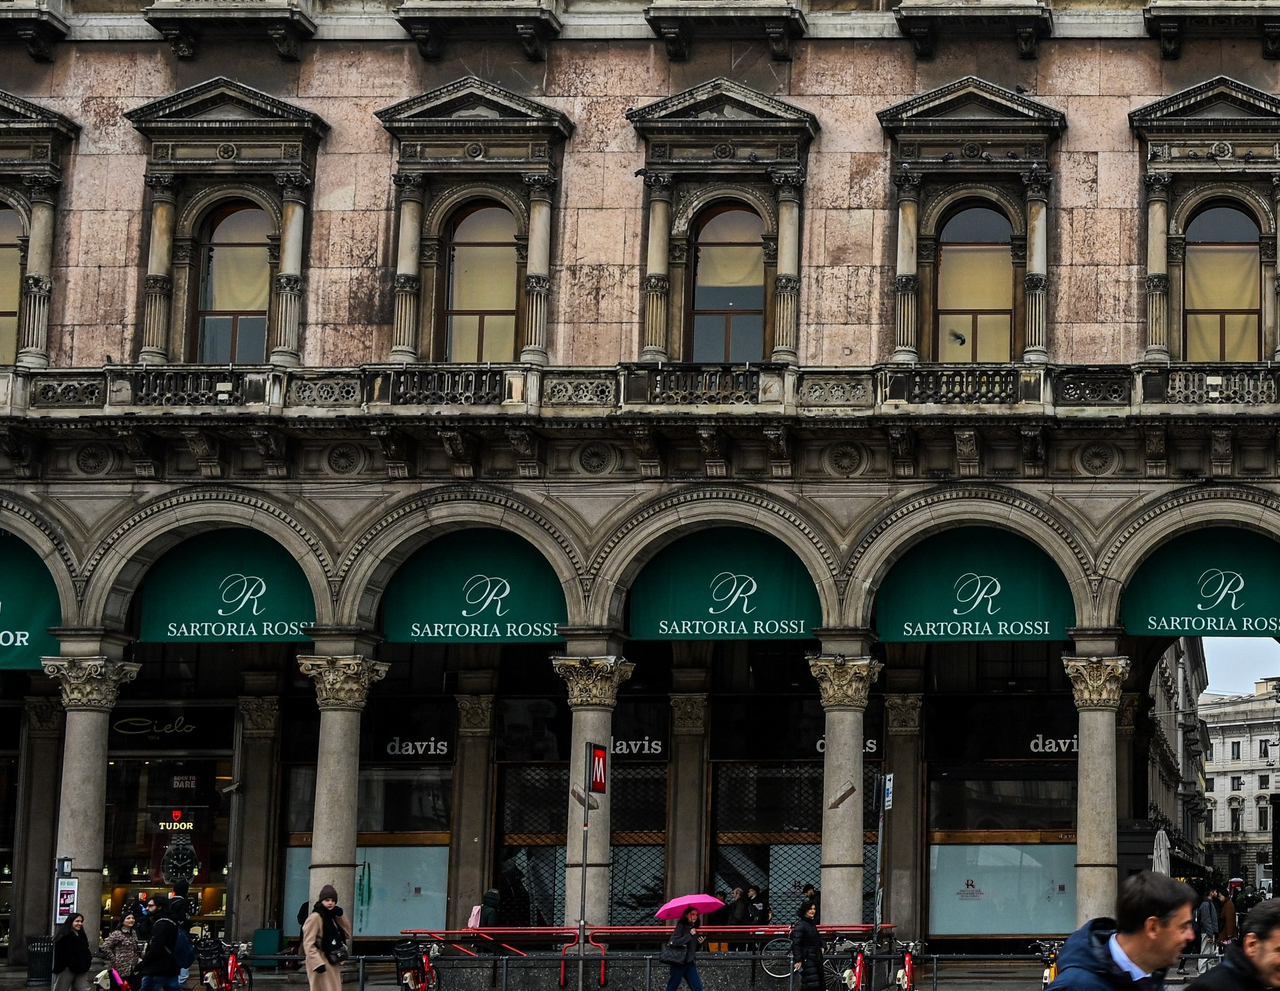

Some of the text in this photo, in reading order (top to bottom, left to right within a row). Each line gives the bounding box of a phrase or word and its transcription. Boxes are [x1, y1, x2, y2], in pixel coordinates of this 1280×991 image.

[217, 573, 267, 616] R
[461, 574, 511, 617] R
[708, 571, 758, 614] R
[952, 572, 1001, 615] R
[1196, 568, 1245, 610] R
[167, 621, 315, 637] SARTORIA ROSS
[411, 623, 559, 637] SARTORIA ROSSI
[658, 619, 806, 634] SARTORIA ROSSI
[903, 621, 1050, 636] SARTORIA ROSSI
[1147, 615, 1238, 631] SARTORIA
[0, 631, 30, 646] OR
[113, 716, 196, 734] Cielo
[386, 736, 448, 755] davis
[1030, 734, 1078, 752] davi
[592, 756, 605, 783] M
[173, 780, 196, 788] DARE
[159, 822, 194, 830] TUDOR
